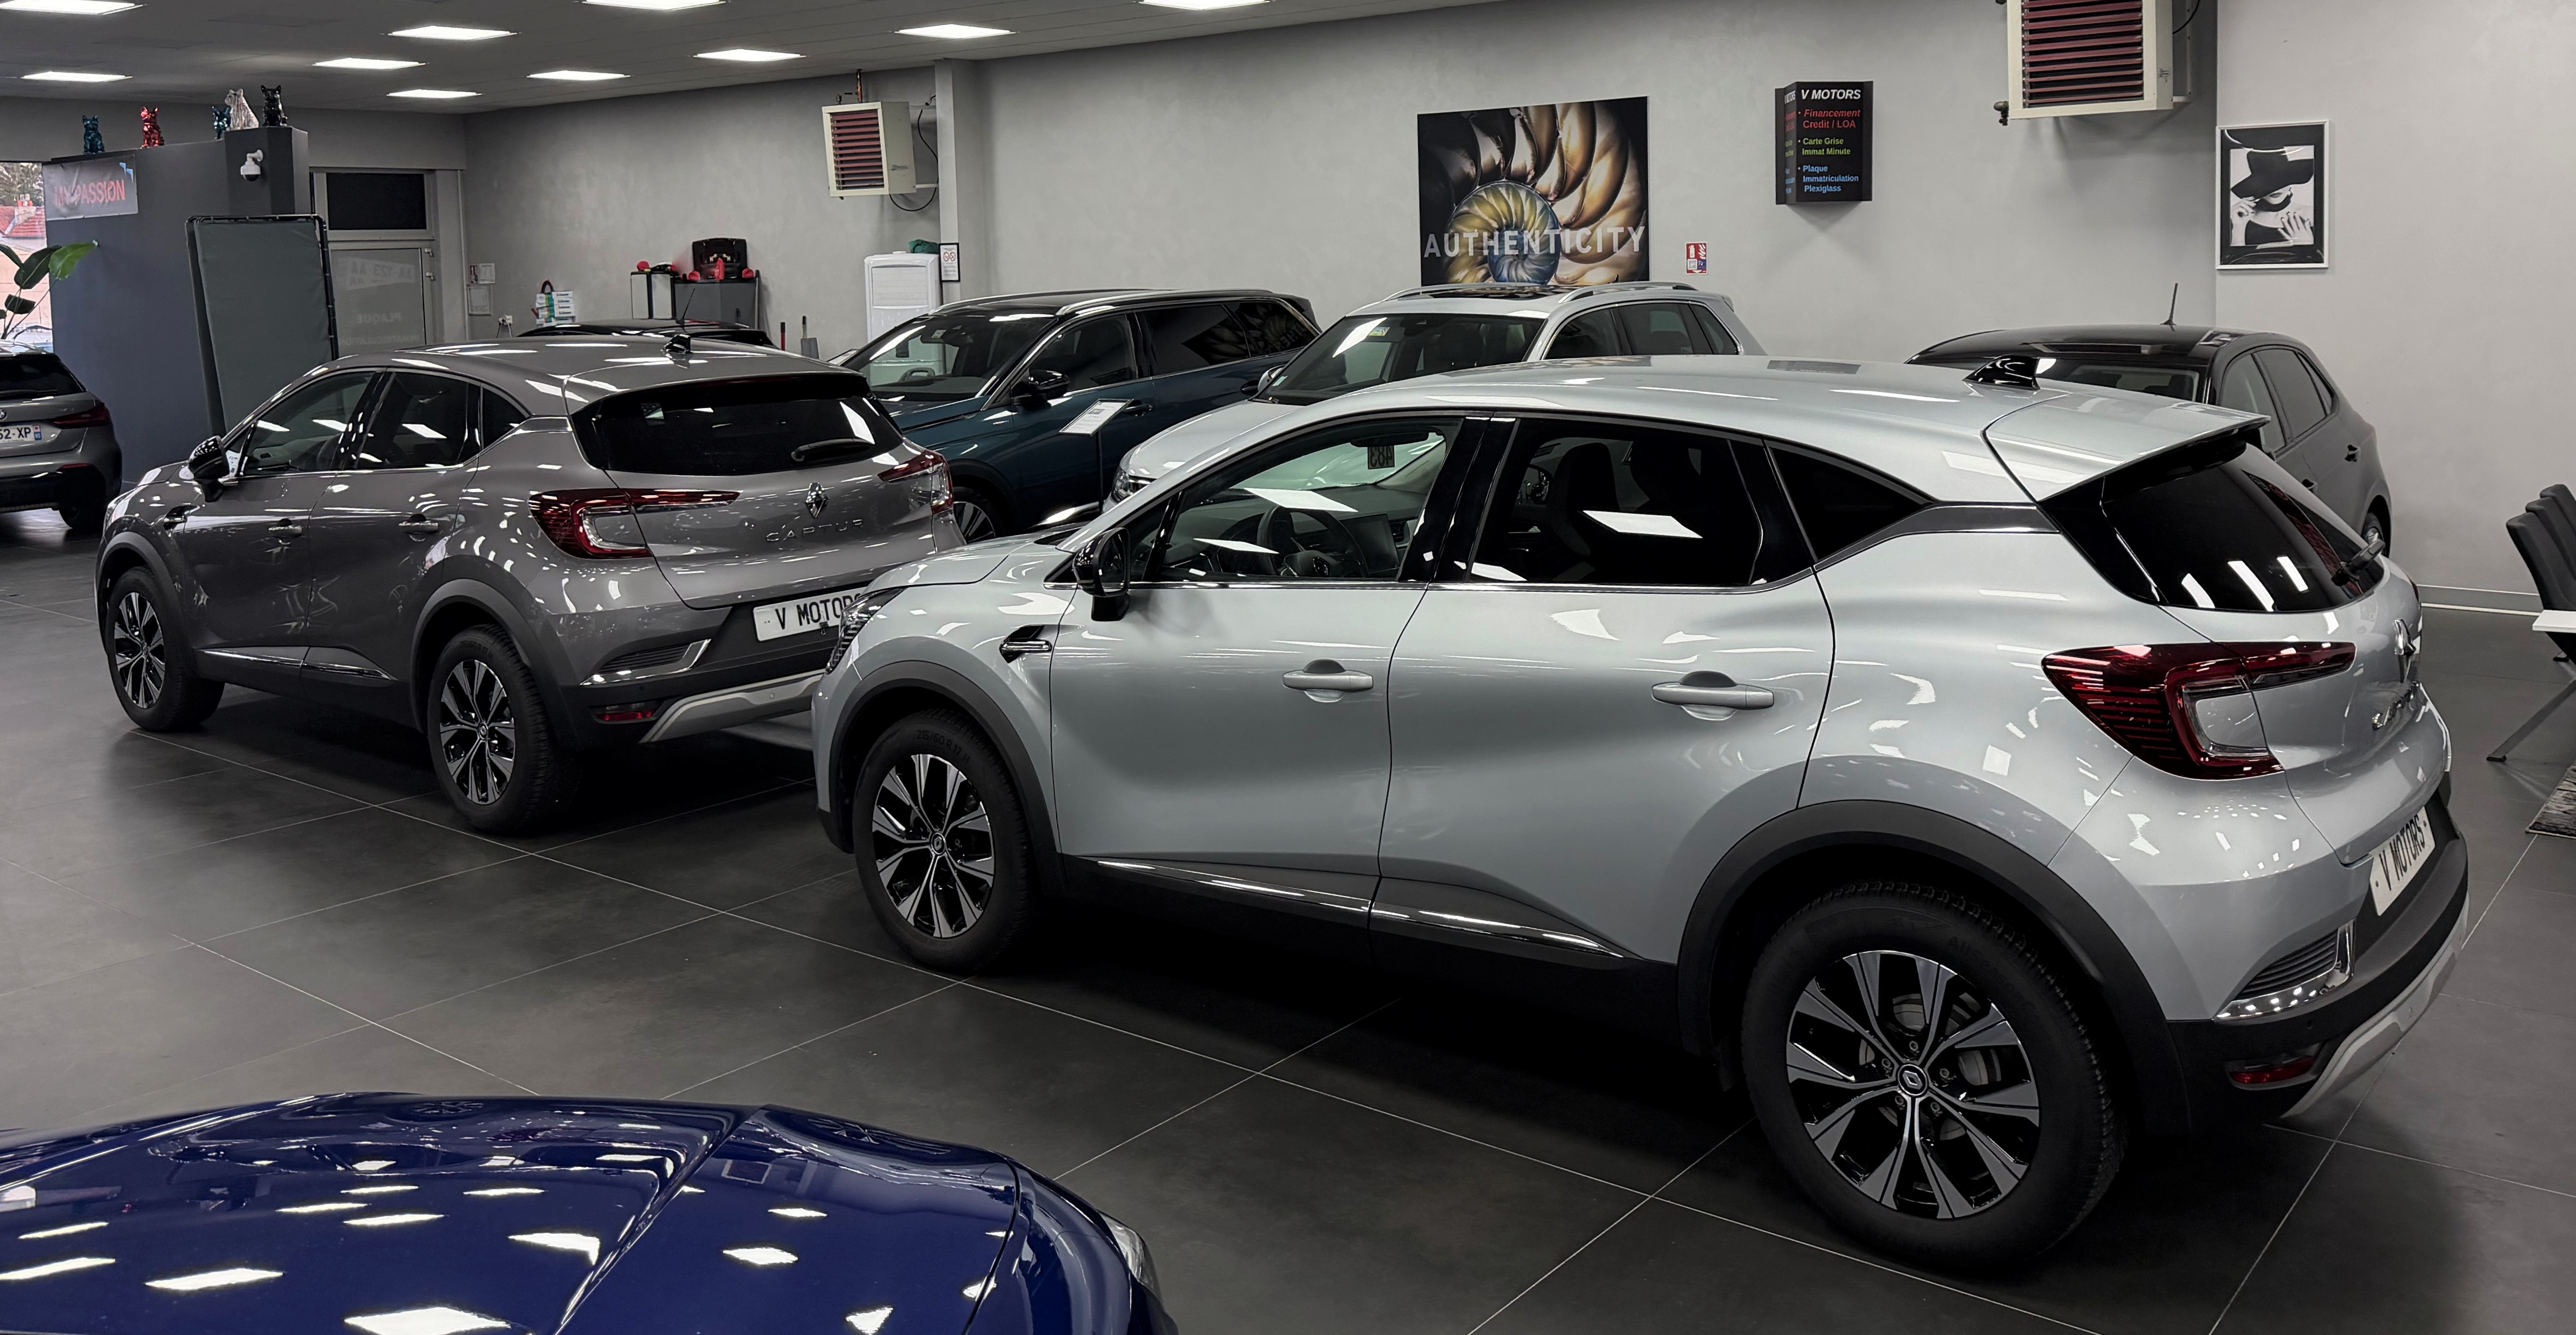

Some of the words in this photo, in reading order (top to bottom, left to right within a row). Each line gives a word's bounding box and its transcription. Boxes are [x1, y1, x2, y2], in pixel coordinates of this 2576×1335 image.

[1801, 89, 1810, 100] V
[1811, 89, 1861, 100] MOTORS
[1804, 109, 1861, 117] Financement
[1803, 120, 1829, 128] Credit
[1837, 120, 1856, 128] LOA
[1824, 137, 1844, 145] Grise
[1803, 165, 1828, 173] Plaque
[74, 179, 126, 205] PASSION
[1804, 184, 1842, 194] Plexiglass
[1423, 226, 1645, 258] AUTHENTICITY
[765, 518, 864, 542] CAPTUR
[775, 607, 786, 630] V
[796, 593, 861, 627] MOTO
[2379, 848, 2392, 892] V
[2389, 813, 2426, 881] MOTORS
